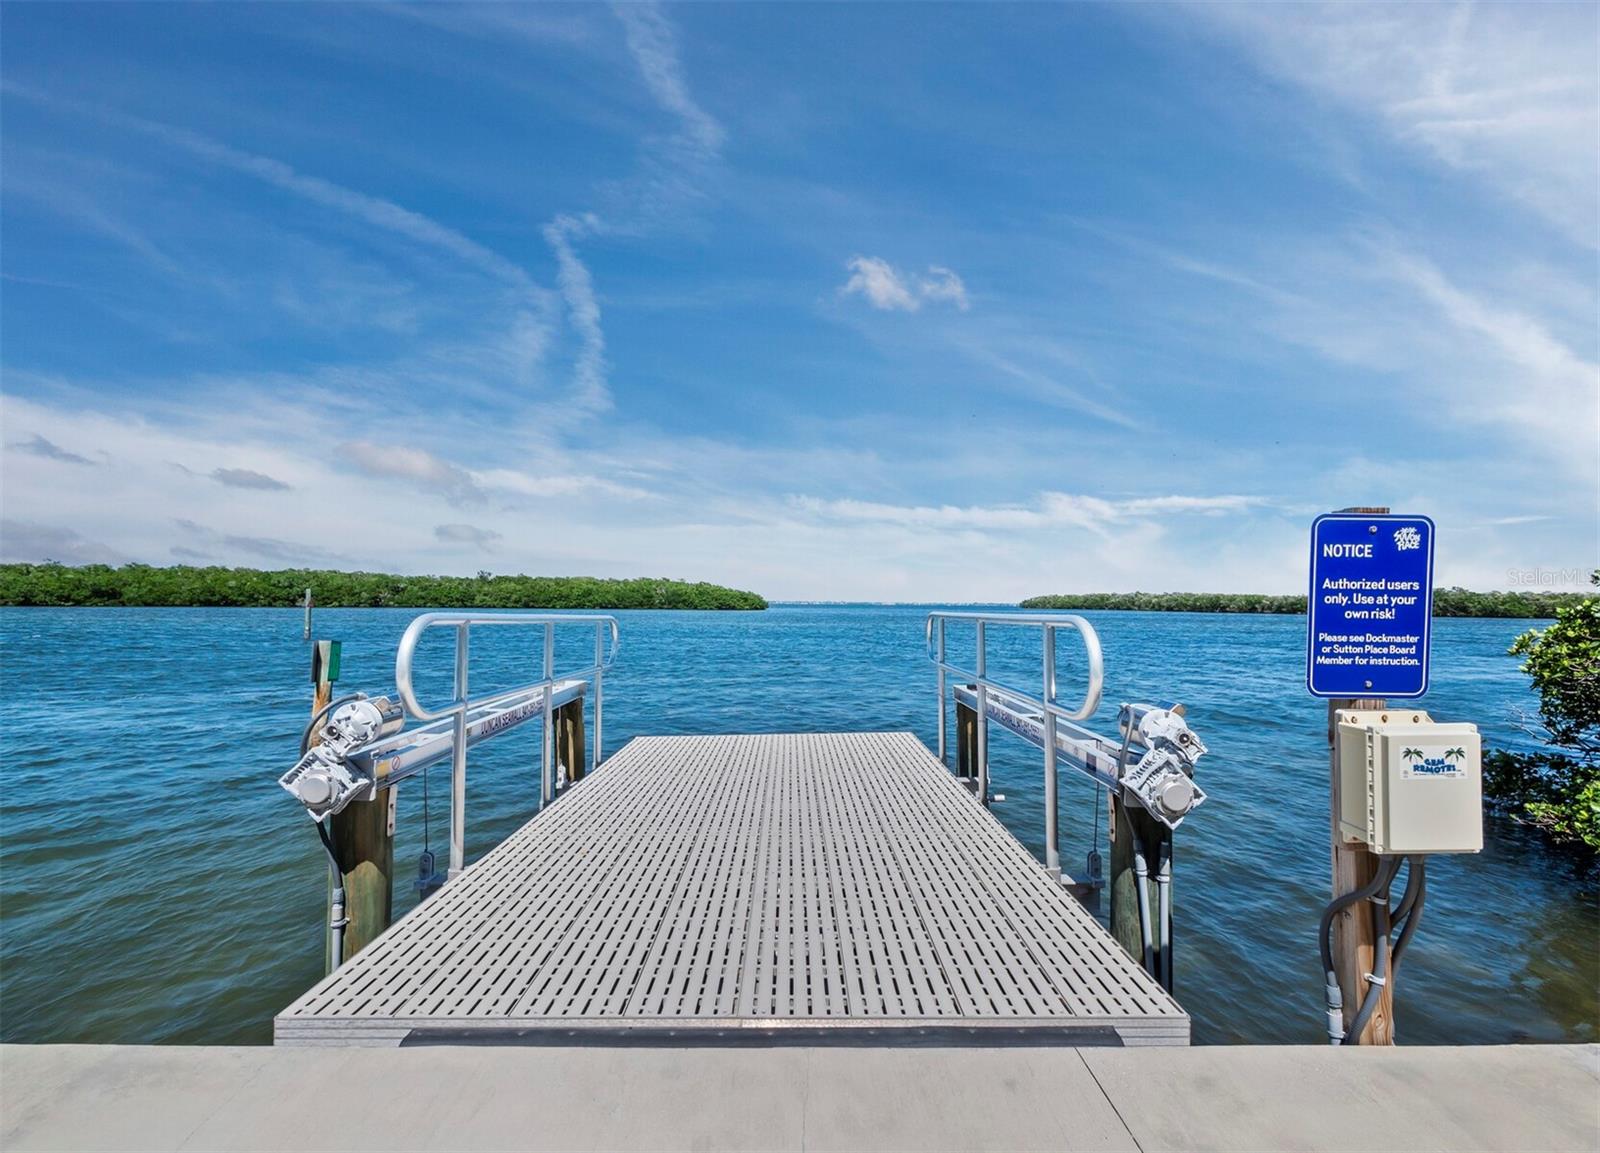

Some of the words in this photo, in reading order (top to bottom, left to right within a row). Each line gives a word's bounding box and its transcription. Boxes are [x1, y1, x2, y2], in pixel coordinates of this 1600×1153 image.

[1323, 543, 1373, 558] NOTICE
[1322, 578, 1386, 590] Authorized
[1387, 581, 1420, 590] users
[1324, 593, 1352, 607] only.
[1353, 593, 1374, 605] Use
[1376, 594, 1389, 605] at
[1390, 597, 1418, 607] your
[1344, 610, 1369, 619] own
[1371, 608, 1396, 620] risk!
[1319, 633, 1348, 643] Please
[1349, 635, 1365, 643] see
[1365, 633, 1420, 643] Dockmaster
[1321, 646, 1332, 654] or
[1333, 644, 1364, 654] Sutton
[1364, 645, 1389, 655] Place
[1389, 645, 1416, 655] Board
[1316, 655, 1354, 665] Member
[1355, 656, 1369, 665] for
[1369, 657, 1420, 666] instruction.
